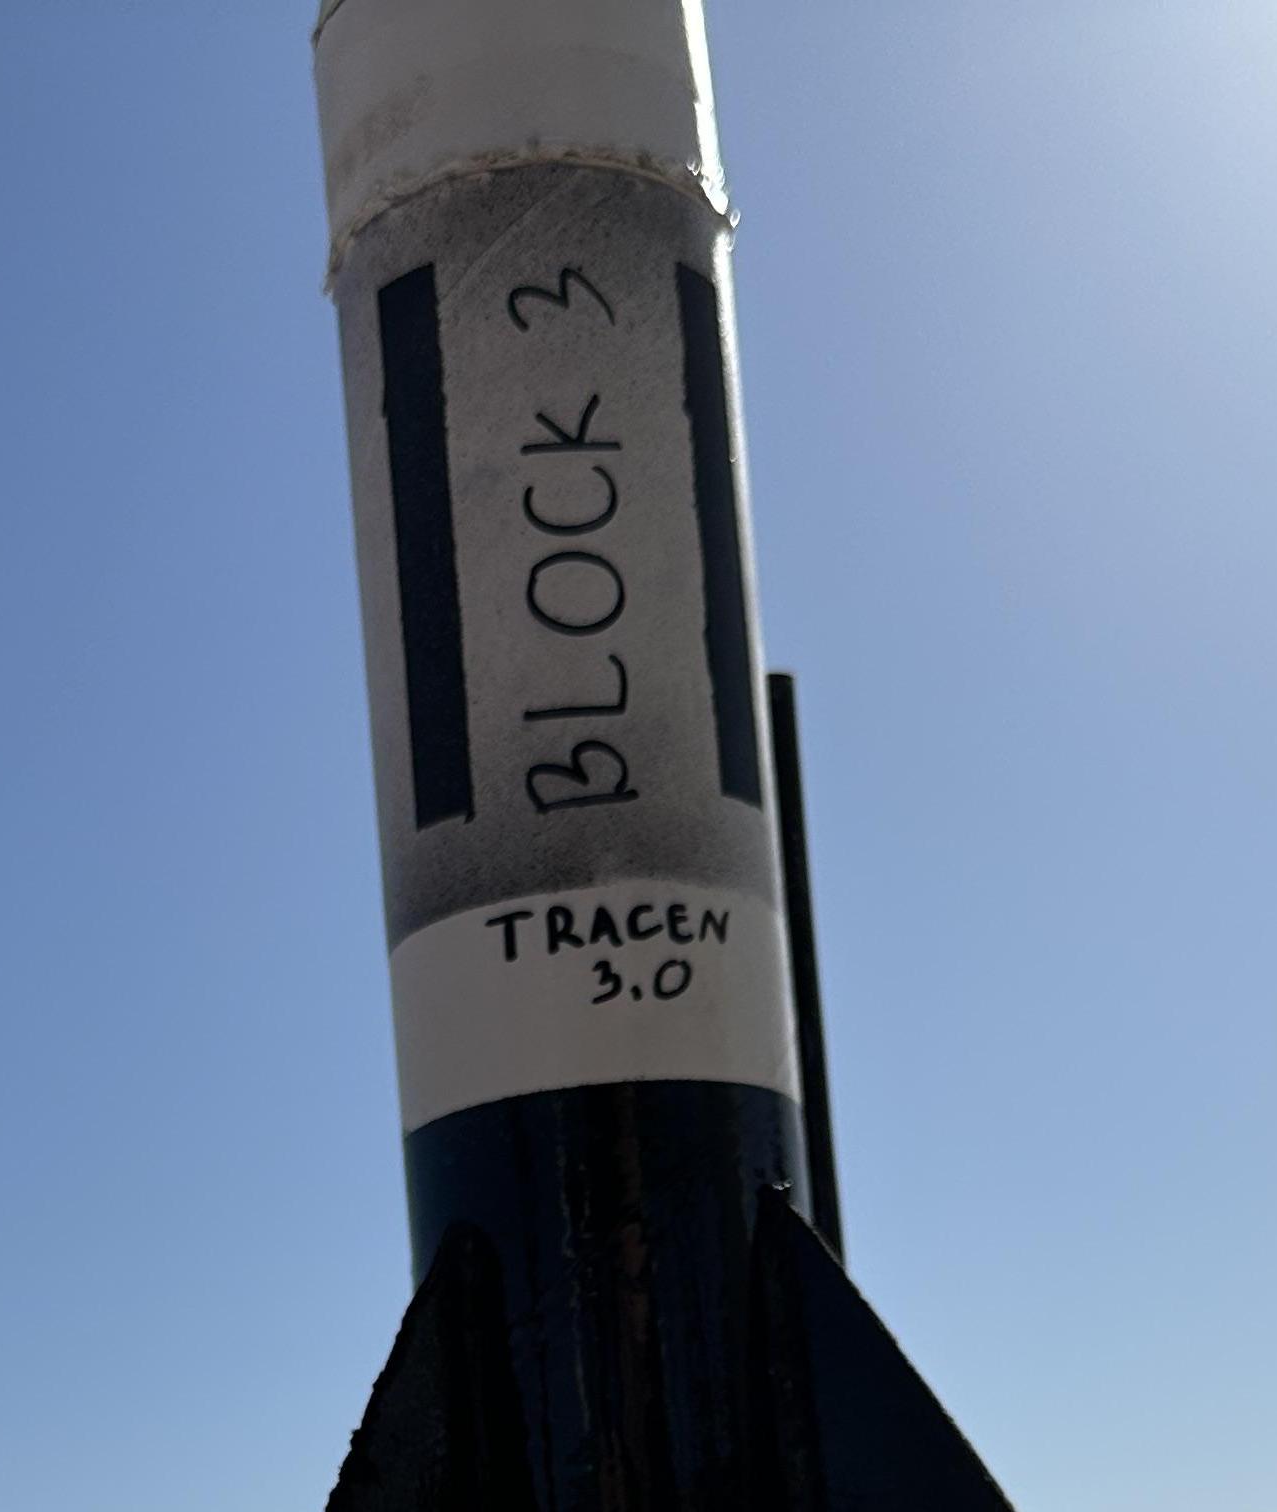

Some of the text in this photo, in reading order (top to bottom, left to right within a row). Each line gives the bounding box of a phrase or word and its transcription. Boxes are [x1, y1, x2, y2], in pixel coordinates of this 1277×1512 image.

[506, 265, 639, 814] BLOCK 3
[485, 903, 730, 962] TRACEN
[590, 959, 693, 1005] 3.0
